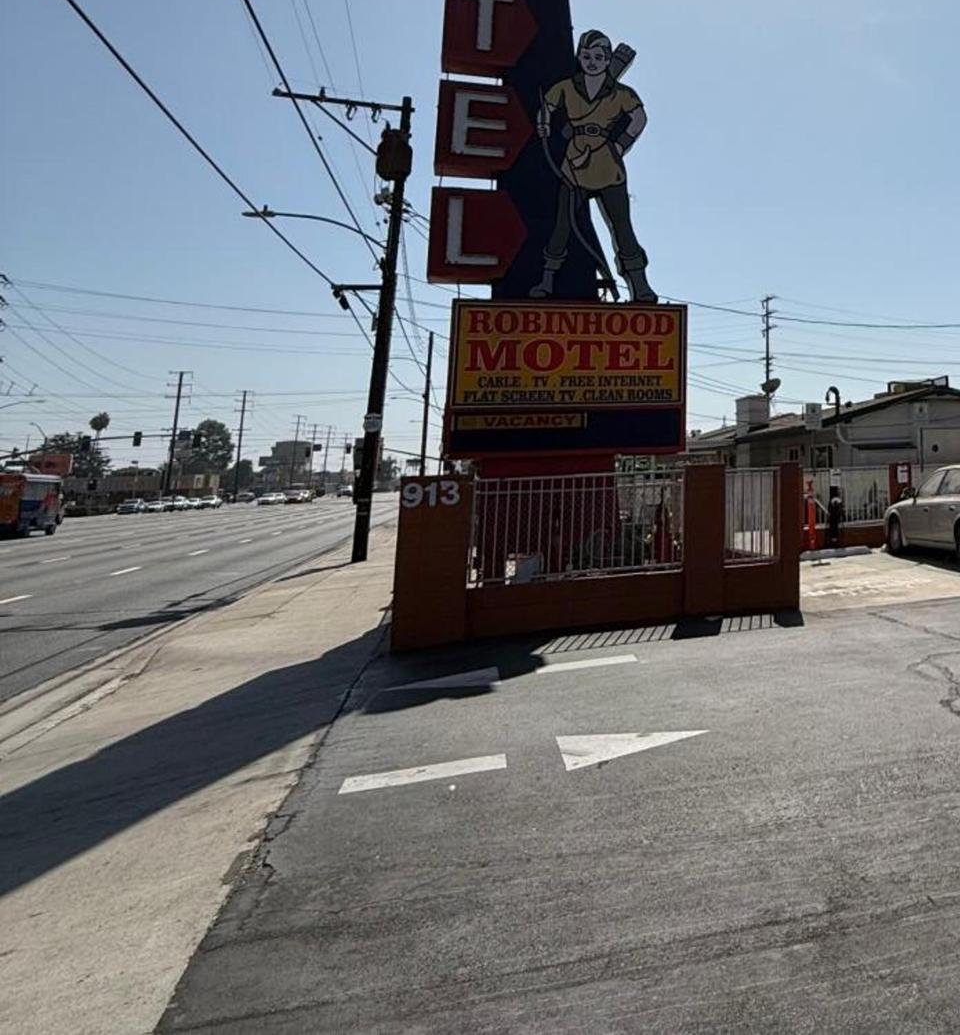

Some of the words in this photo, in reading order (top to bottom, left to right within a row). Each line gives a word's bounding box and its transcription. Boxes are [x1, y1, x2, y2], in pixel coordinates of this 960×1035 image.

[466, 309, 675, 336] ROBINHOOD
[464, 339, 674, 372] MOTEL
[532, 375, 550, 388] TV
[560, 375, 596, 388] FREE
[598, 375, 663, 388] INTERNET
[463, 390, 499, 403] FLAT
[501, 390, 558, 403] SCREEN
[559, 390, 577, 402] TV
[627, 388, 673, 400] ROOMS
[483, 414, 576, 428] VACANCY
[402, 480, 461, 508] 913
